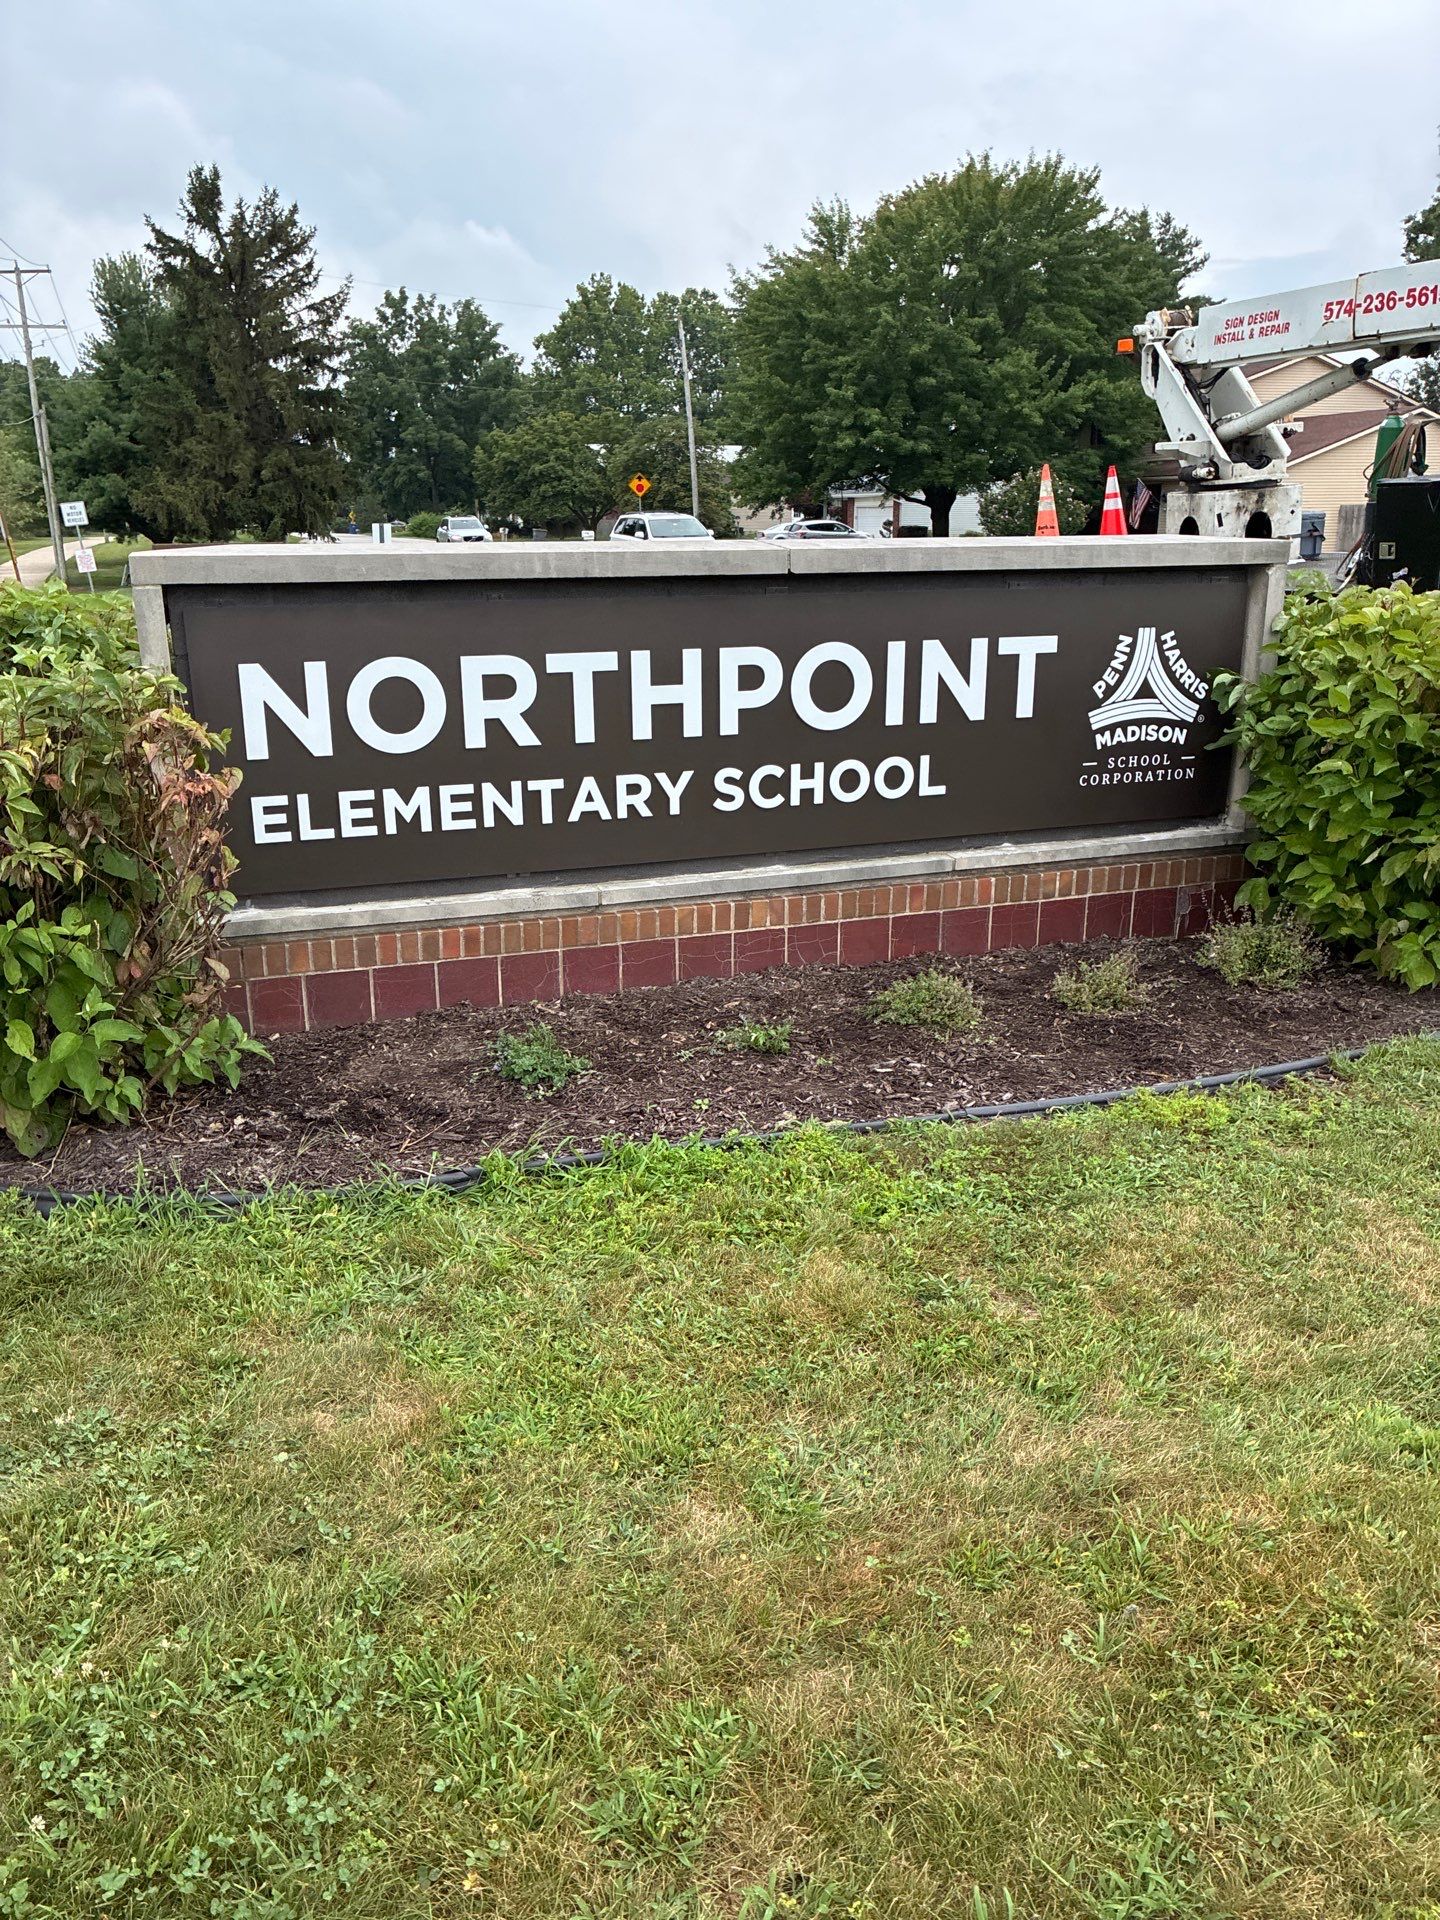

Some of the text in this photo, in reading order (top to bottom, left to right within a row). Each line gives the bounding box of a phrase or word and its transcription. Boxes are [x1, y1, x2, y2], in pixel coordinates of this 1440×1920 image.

[1323, 285, 1440, 320] 574-236-561
[1213, 322, 1290, 346] INSTALL & REPAIR
[1224, 310, 1280, 331] SIGN DESIGN
[1092, 634, 1134, 699] PENN
[1160, 630, 1209, 700] HARRIS
[238, 635, 1058, 760] NORTHPOINT
[1095, 724, 1188, 751] MADISON
[1107, 753, 1171, 769] SCHOOL
[1079, 767, 1196, 787] CORPORATION
[250, 754, 947, 845] ELEMENTARY SCHOOL
